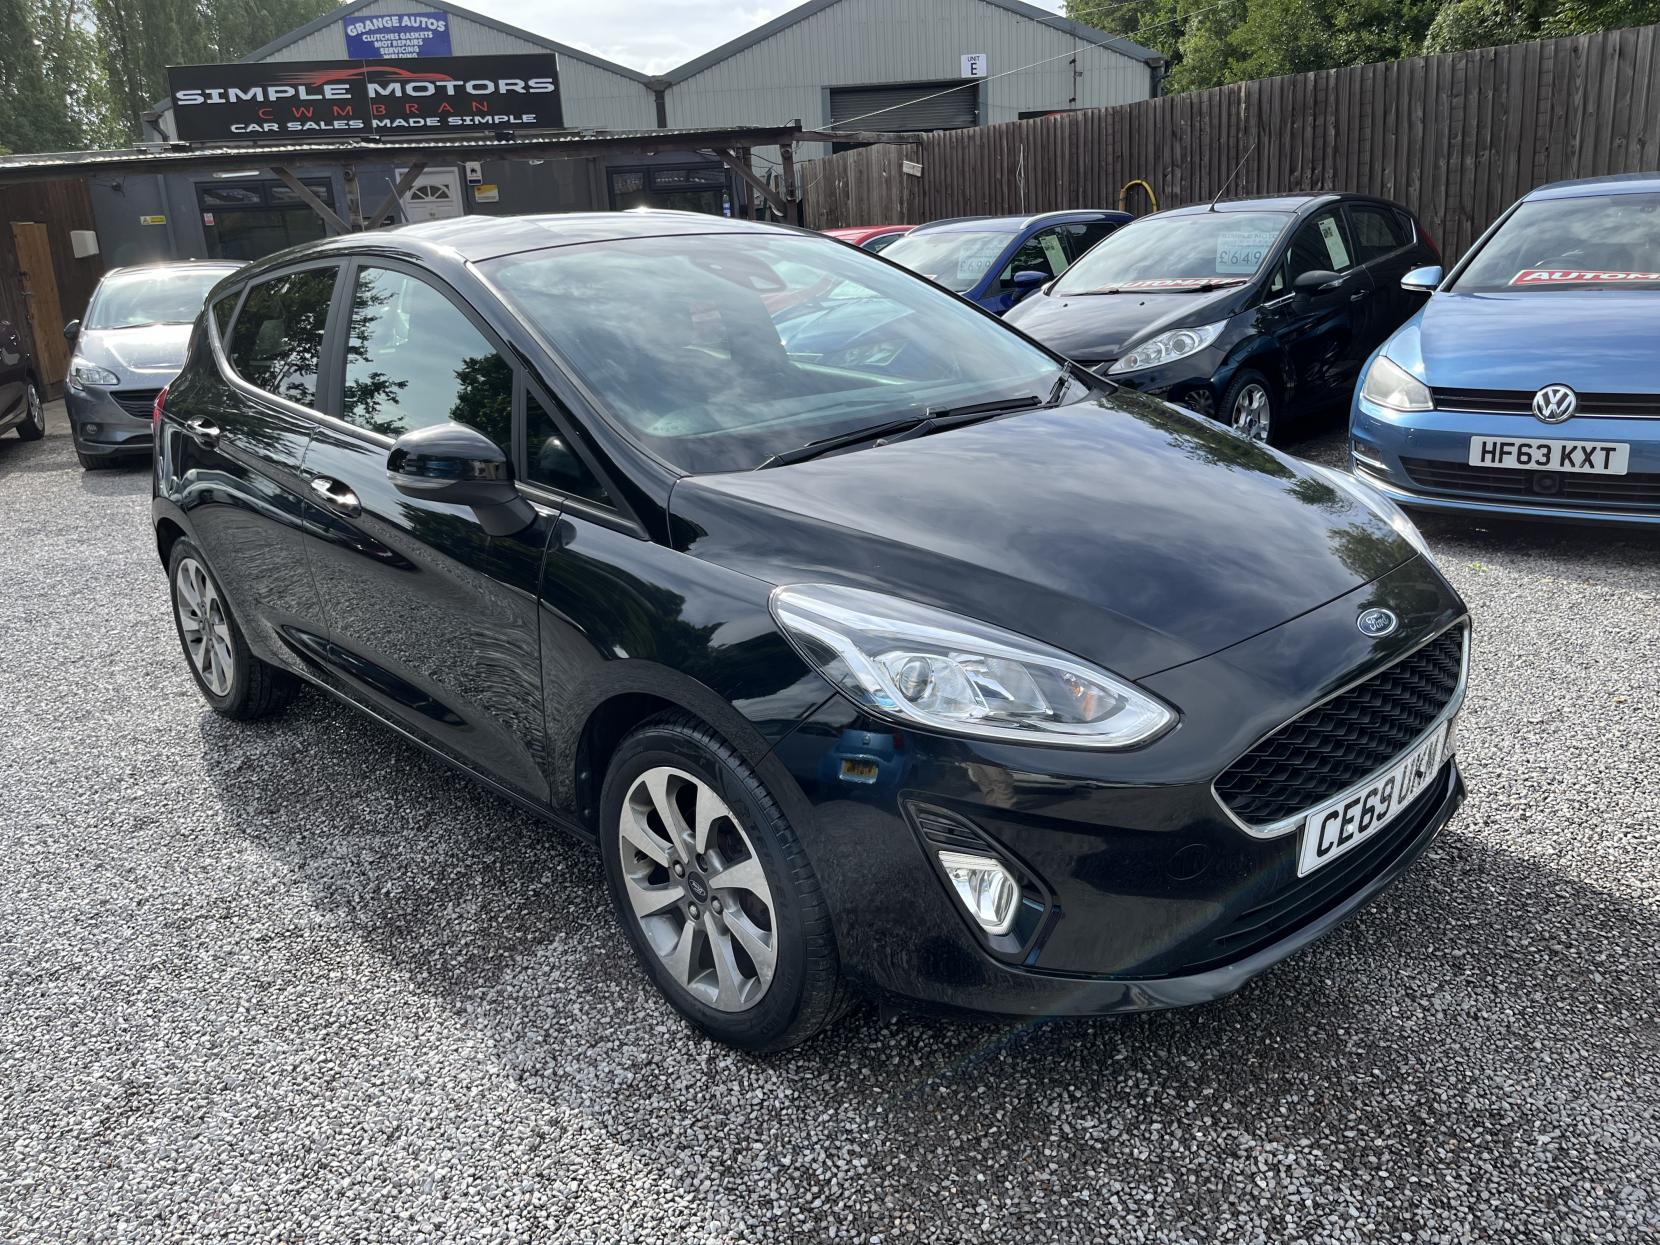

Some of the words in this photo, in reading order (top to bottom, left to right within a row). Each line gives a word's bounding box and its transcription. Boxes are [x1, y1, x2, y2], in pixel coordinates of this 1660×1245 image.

[347, 16, 399, 36] GRANGE
[401, 16, 446, 31] AUTOS
[362, 33, 399, 41] CLUTCHES
[400, 31, 433, 39] GASKETS
[380, 46, 419, 54] SERVICING
[971, 62, 978, 76] E
[175, 84, 352, 105] SIMPLE
[367, 78, 555, 98] MOTORS
[258, 101, 488, 119] CWMBRAN
[230, 122, 280, 133] CAR
[286, 120, 365, 131] SALES
[372, 117, 441, 128] MADE
[447, 114, 537, 125] SIMPLE
[1523, 272, 1660, 280] AUTOM
[1480, 441, 1552, 466] HF63
[1559, 445, 1617, 470] KXT
[1365, 614, 1388, 631] Ford
[1316, 775, 1396, 858] CE69
